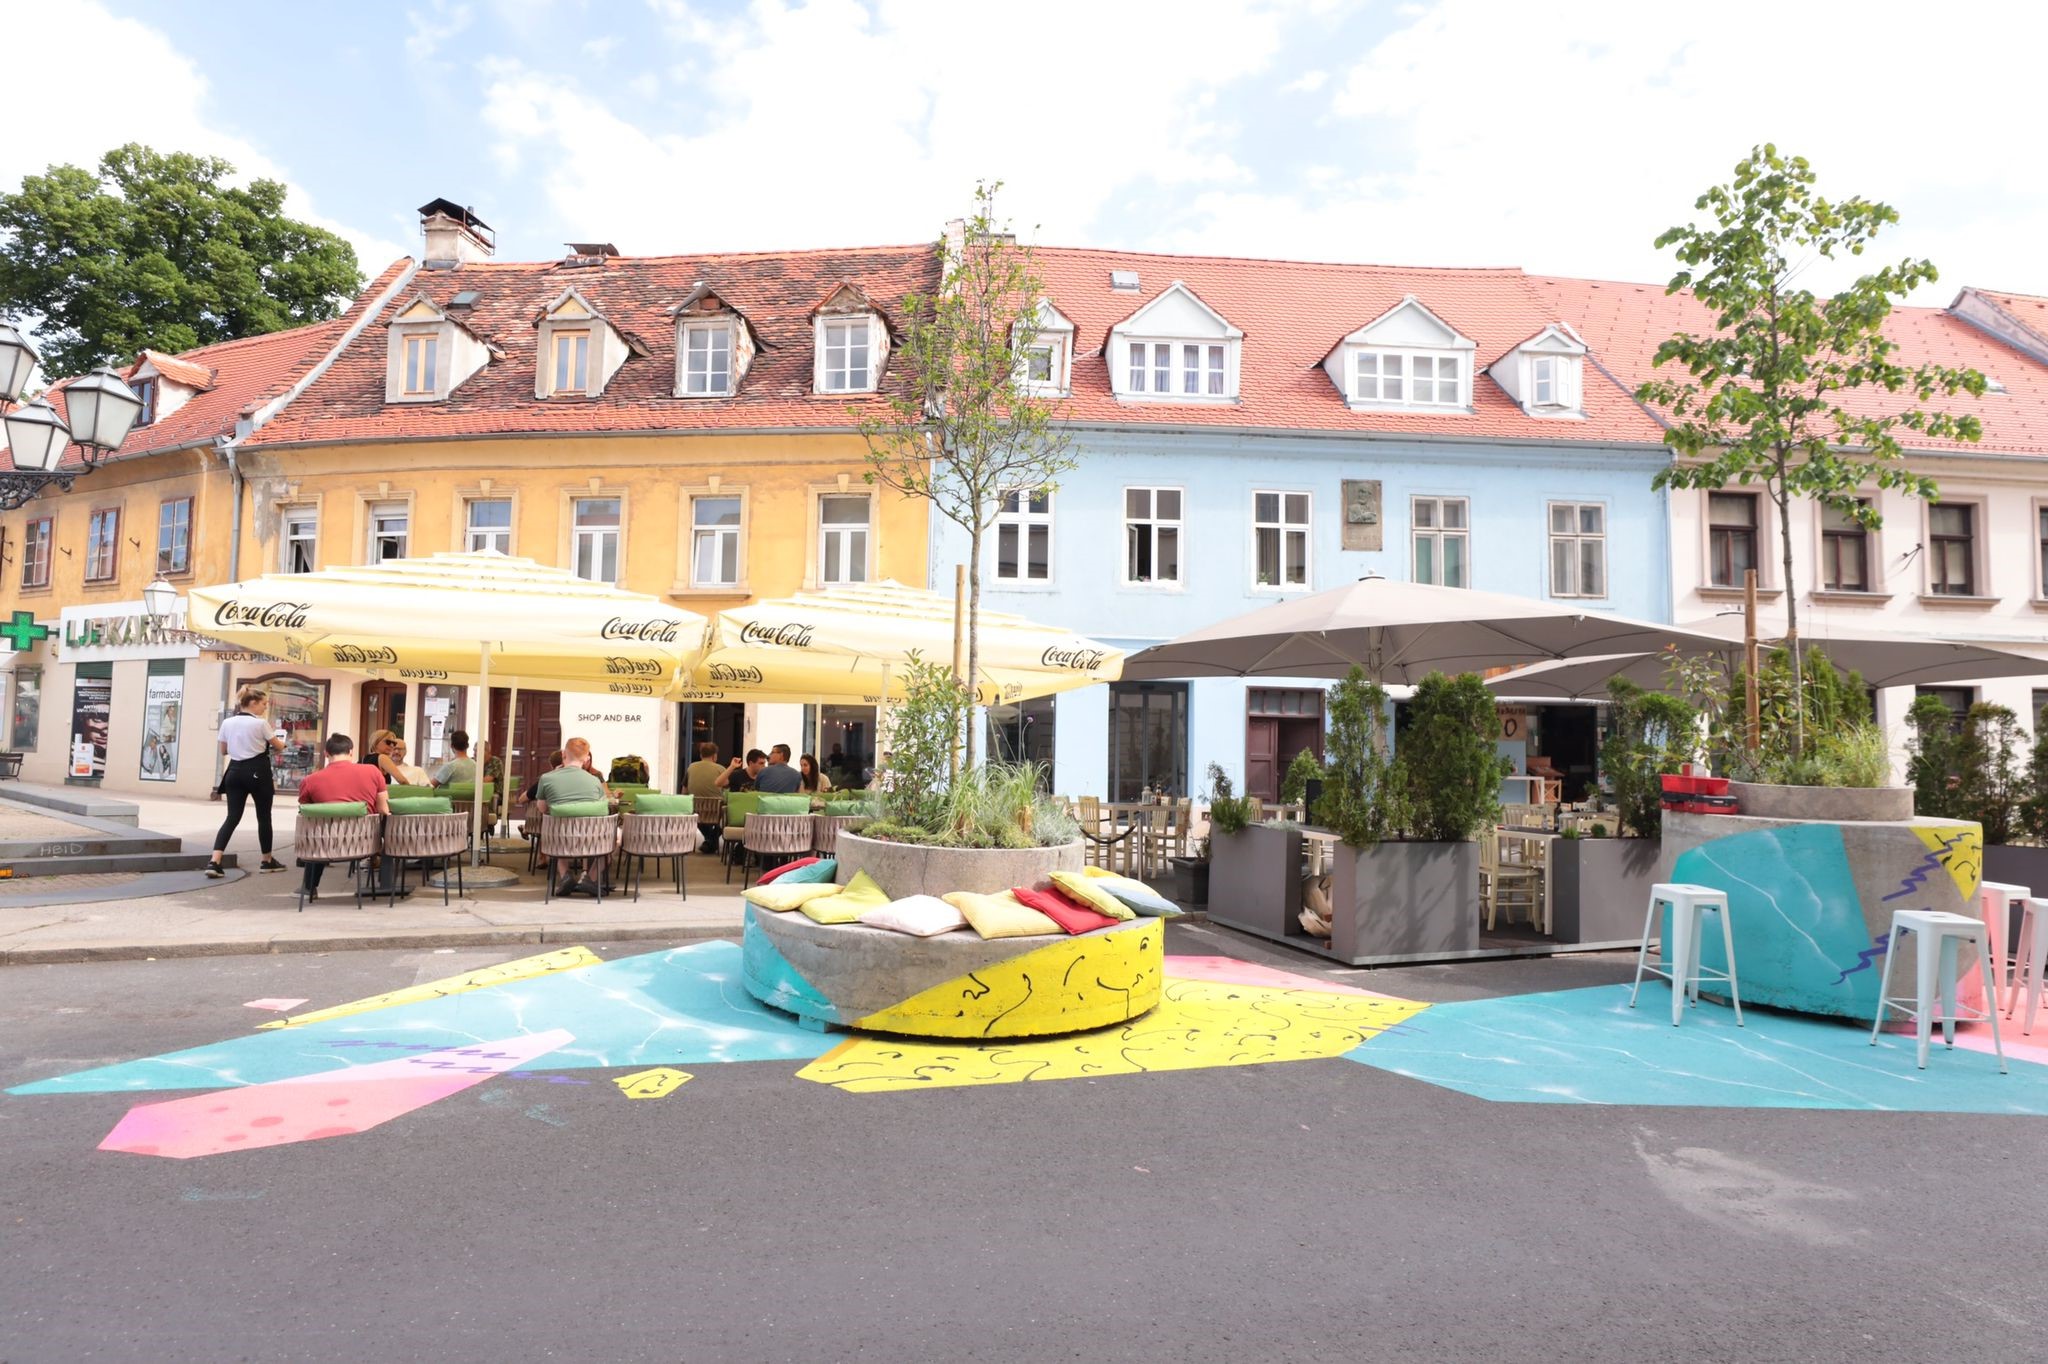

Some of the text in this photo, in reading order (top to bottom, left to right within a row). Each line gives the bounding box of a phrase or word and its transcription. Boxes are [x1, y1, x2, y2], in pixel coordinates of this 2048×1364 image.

[215, 600, 312, 628] Coca-Cola
[601, 616, 681, 643] Coca-Cola
[740, 620, 816, 647] Coca-Cola
[1041, 646, 1106, 671] Coca-Cola
[149, 688, 181, 699] farmacia
[578, 713, 642, 723] SHOP AND BAR
